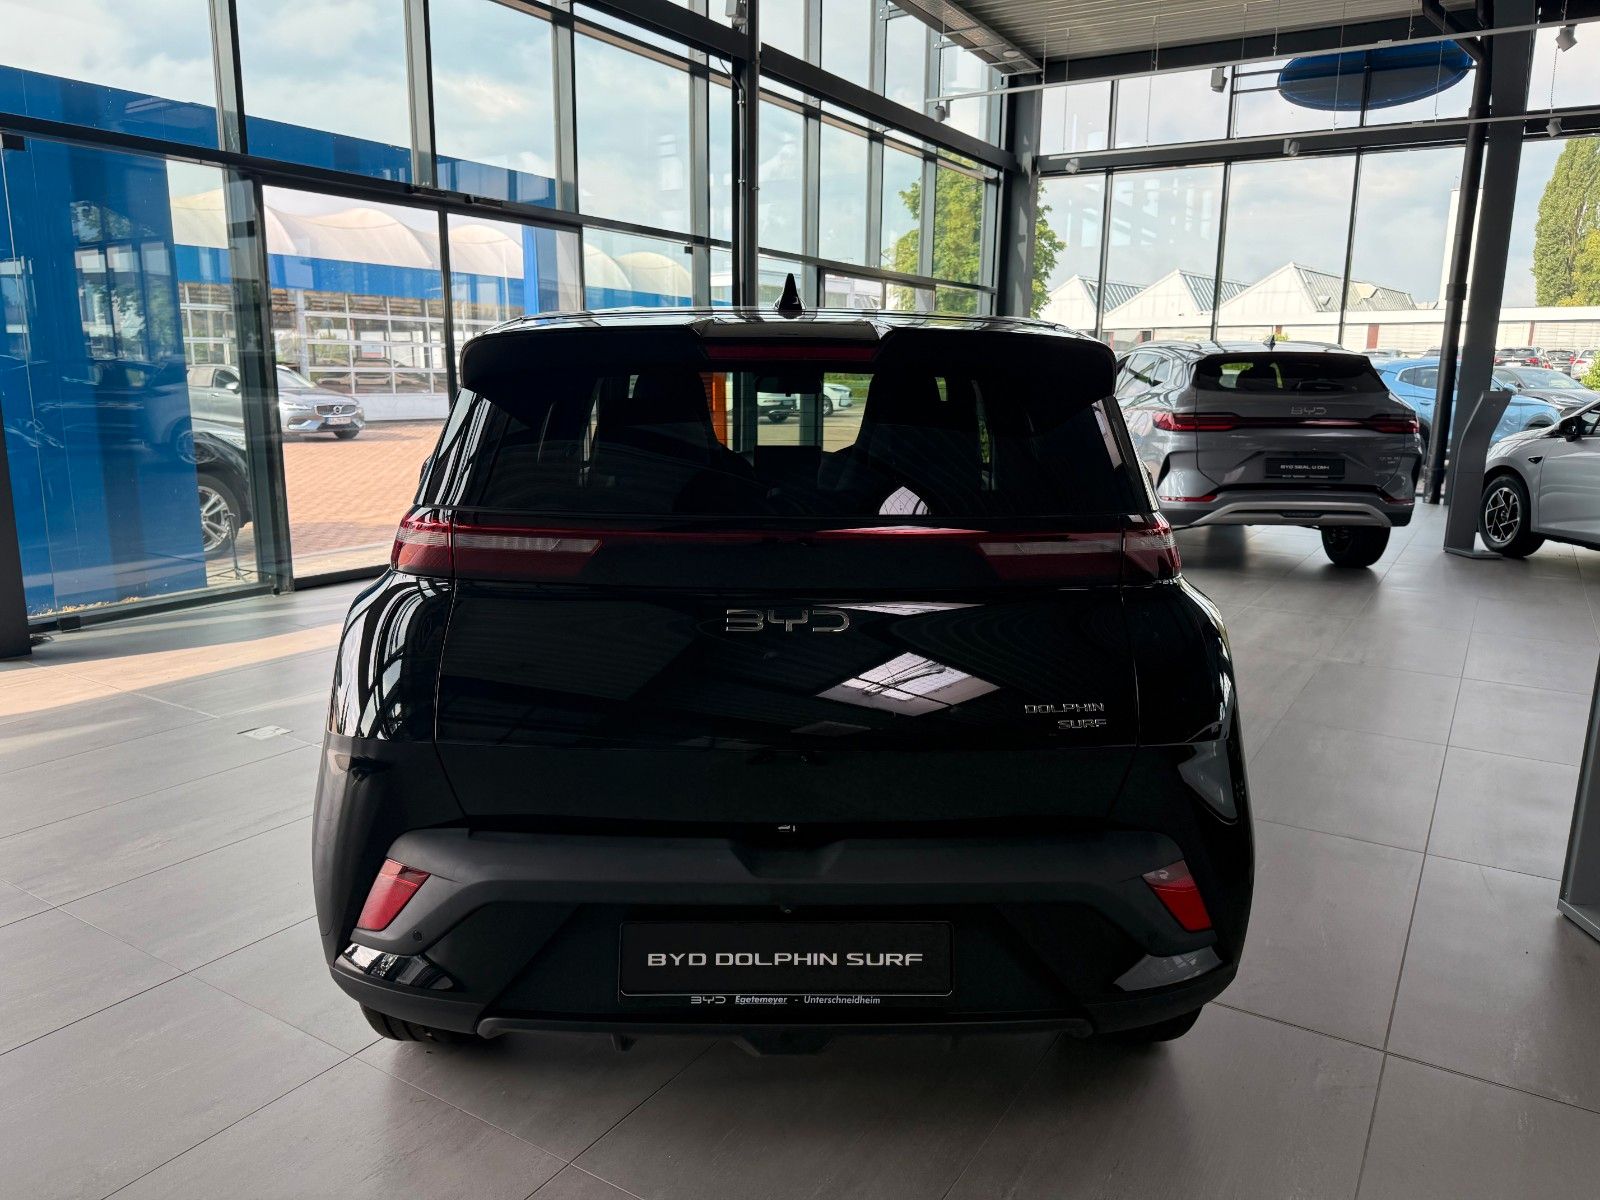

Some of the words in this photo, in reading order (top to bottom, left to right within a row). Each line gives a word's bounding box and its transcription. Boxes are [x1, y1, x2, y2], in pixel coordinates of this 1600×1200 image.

[1290, 406, 1327, 415] BYD
[726, 609, 850, 632] BYD
[1024, 702, 1105, 714] DOLPHIN
[1057, 719, 1107, 729] SURF
[647, 953, 707, 967] BYD
[715, 952, 838, 966] DOLPHIN
[846, 953, 923, 966] SURF
[690, 996, 727, 1005] BYD
[734, 995, 788, 1006] Egetemeyer
[803, 995, 881, 1005] Unterschneidheim
